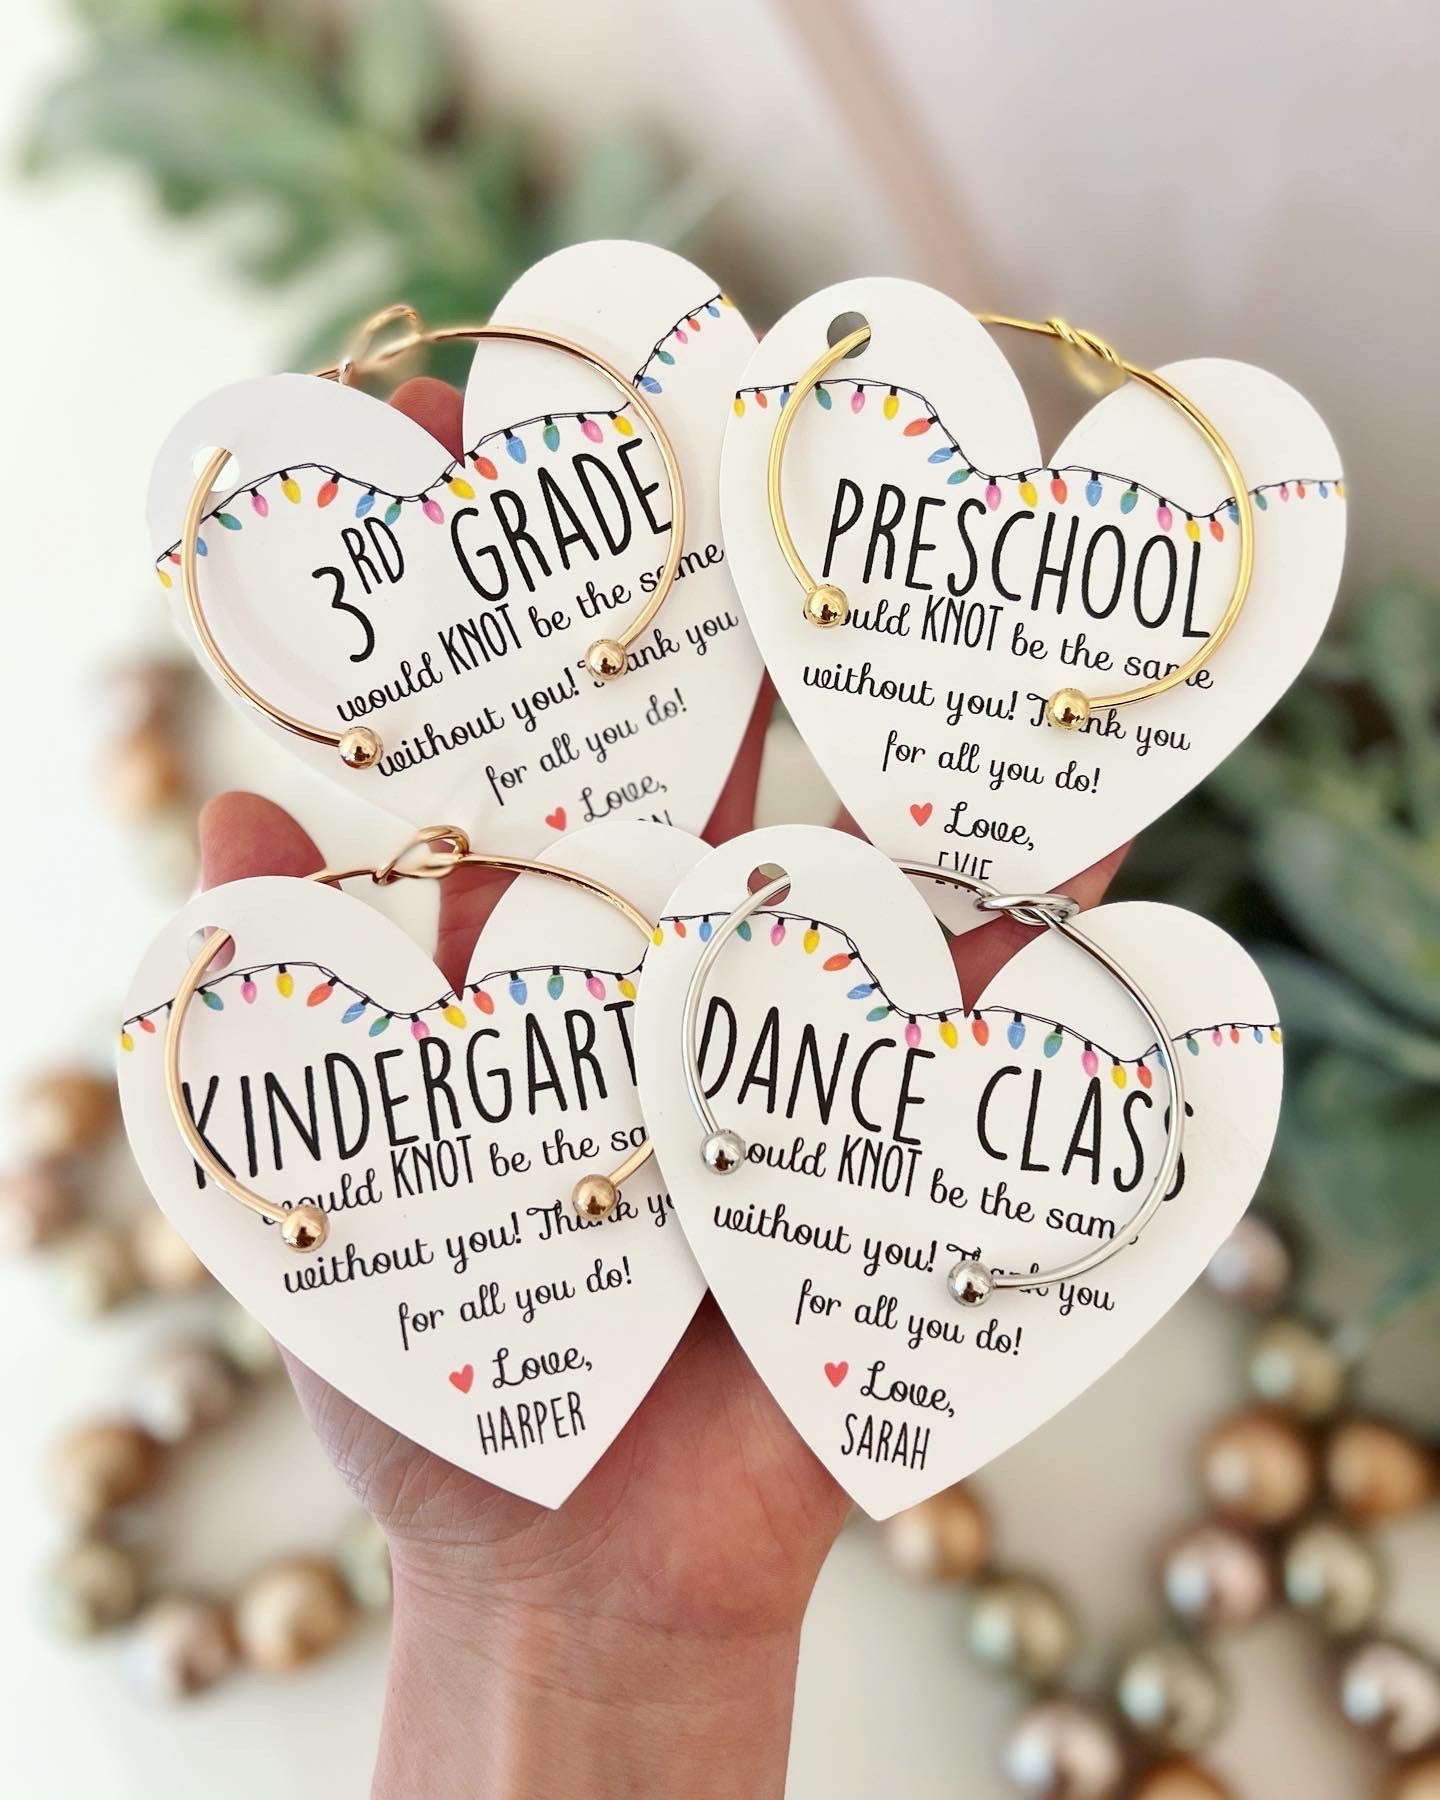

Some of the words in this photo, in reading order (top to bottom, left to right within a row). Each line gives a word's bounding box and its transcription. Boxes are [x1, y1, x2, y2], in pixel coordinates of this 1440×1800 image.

[312, 517, 404, 662] 3RD
[451, 438, 671, 601] GRADE
[822, 478, 1211, 638] PRESCHOOL
[337, 652, 442, 722] would
[438, 603, 522, 675] KNOT
[529, 607, 571, 638] be
[576, 581, 631, 618] the
[921, 594, 1004, 651] KNOT
[1011, 623, 1048, 660] be
[1060, 633, 1113, 671] the
[377, 708, 504, 776] without
[511, 667, 580, 732] you!
[577, 629, 680, 687] ank
[686, 612, 738, 656] you
[803, 663, 934, 707] without
[946, 691, 1017, 725] you!
[1027, 693, 1126, 739] Tnk
[1137, 726, 1190, 756] you
[485, 764, 527, 805] for
[540, 737, 580, 772] all
[586, 714, 638, 763] you
[646, 688, 687, 727] do!
[882, 730, 926, 771] for
[938, 743, 980, 773] all
[989, 754, 1045, 790] you
[1055, 762, 1100, 794] do!
[578, 776, 667, 822] Love,
[944, 801, 1035, 850] Love,
[181, 1000, 638, 1189] KINDERGART
[698, 996, 935, 1145] DANCE
[263, 1168, 382, 1225] uld
[391, 1135, 474, 1198] KNOT
[490, 1144, 531, 1178] be
[542, 1129, 599, 1166] the
[745, 1137, 826, 1177] ould
[838, 1135, 922, 1197] KNOT
[930, 1168, 968, 1208] be
[981, 1182, 1034, 1222] the
[1046, 1208, 1138, 1245] sam
[284, 1244, 434, 1293] without
[446, 1213, 522, 1274] you!
[714, 1203, 851, 1254] without
[863, 1239, 937, 1275] you!
[1059, 1282, 1114, 1316] you
[398, 1301, 444, 1351] for
[460, 1283, 505, 1323] all
[516, 1280, 575, 1323] you
[586, 1256, 632, 1292] do!
[795, 1279, 842, 1325] for
[854, 1295, 897, 1329] all
[908, 1311, 964, 1349] you
[976, 1319, 1022, 1356] do!
[492, 1344, 593, 1389] Love,
[860, 1360, 955, 1418] Love,
[477, 1390, 586, 1456] HARPER
[841, 1413, 930, 1471] SARAH
